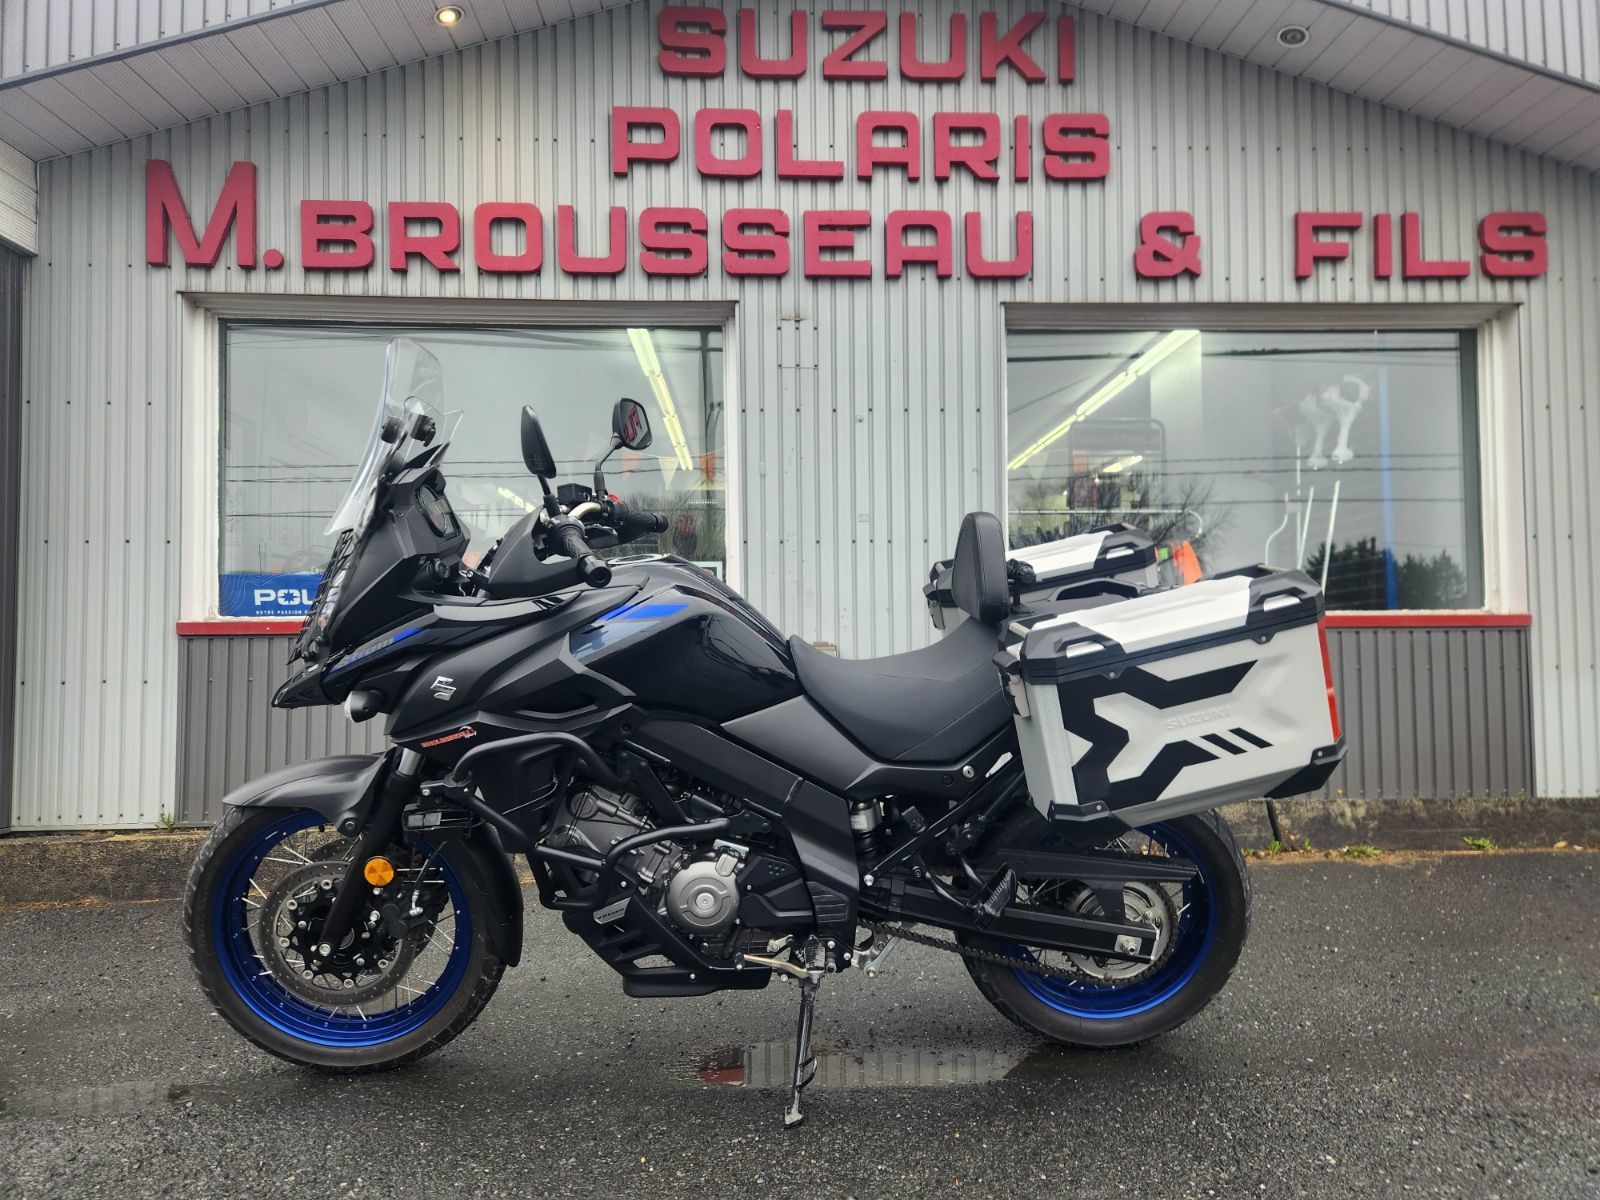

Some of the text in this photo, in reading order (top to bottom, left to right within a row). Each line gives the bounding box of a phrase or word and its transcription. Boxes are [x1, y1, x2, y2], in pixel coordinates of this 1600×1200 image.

[658, 7, 1075, 84] SUZUKI
[611, 106, 1111, 183] POLARIS
[1134, 211, 1202, 280] &
[1295, 211, 1549, 279] FILS
[1165, 704, 1232, 730] SUZUKI
